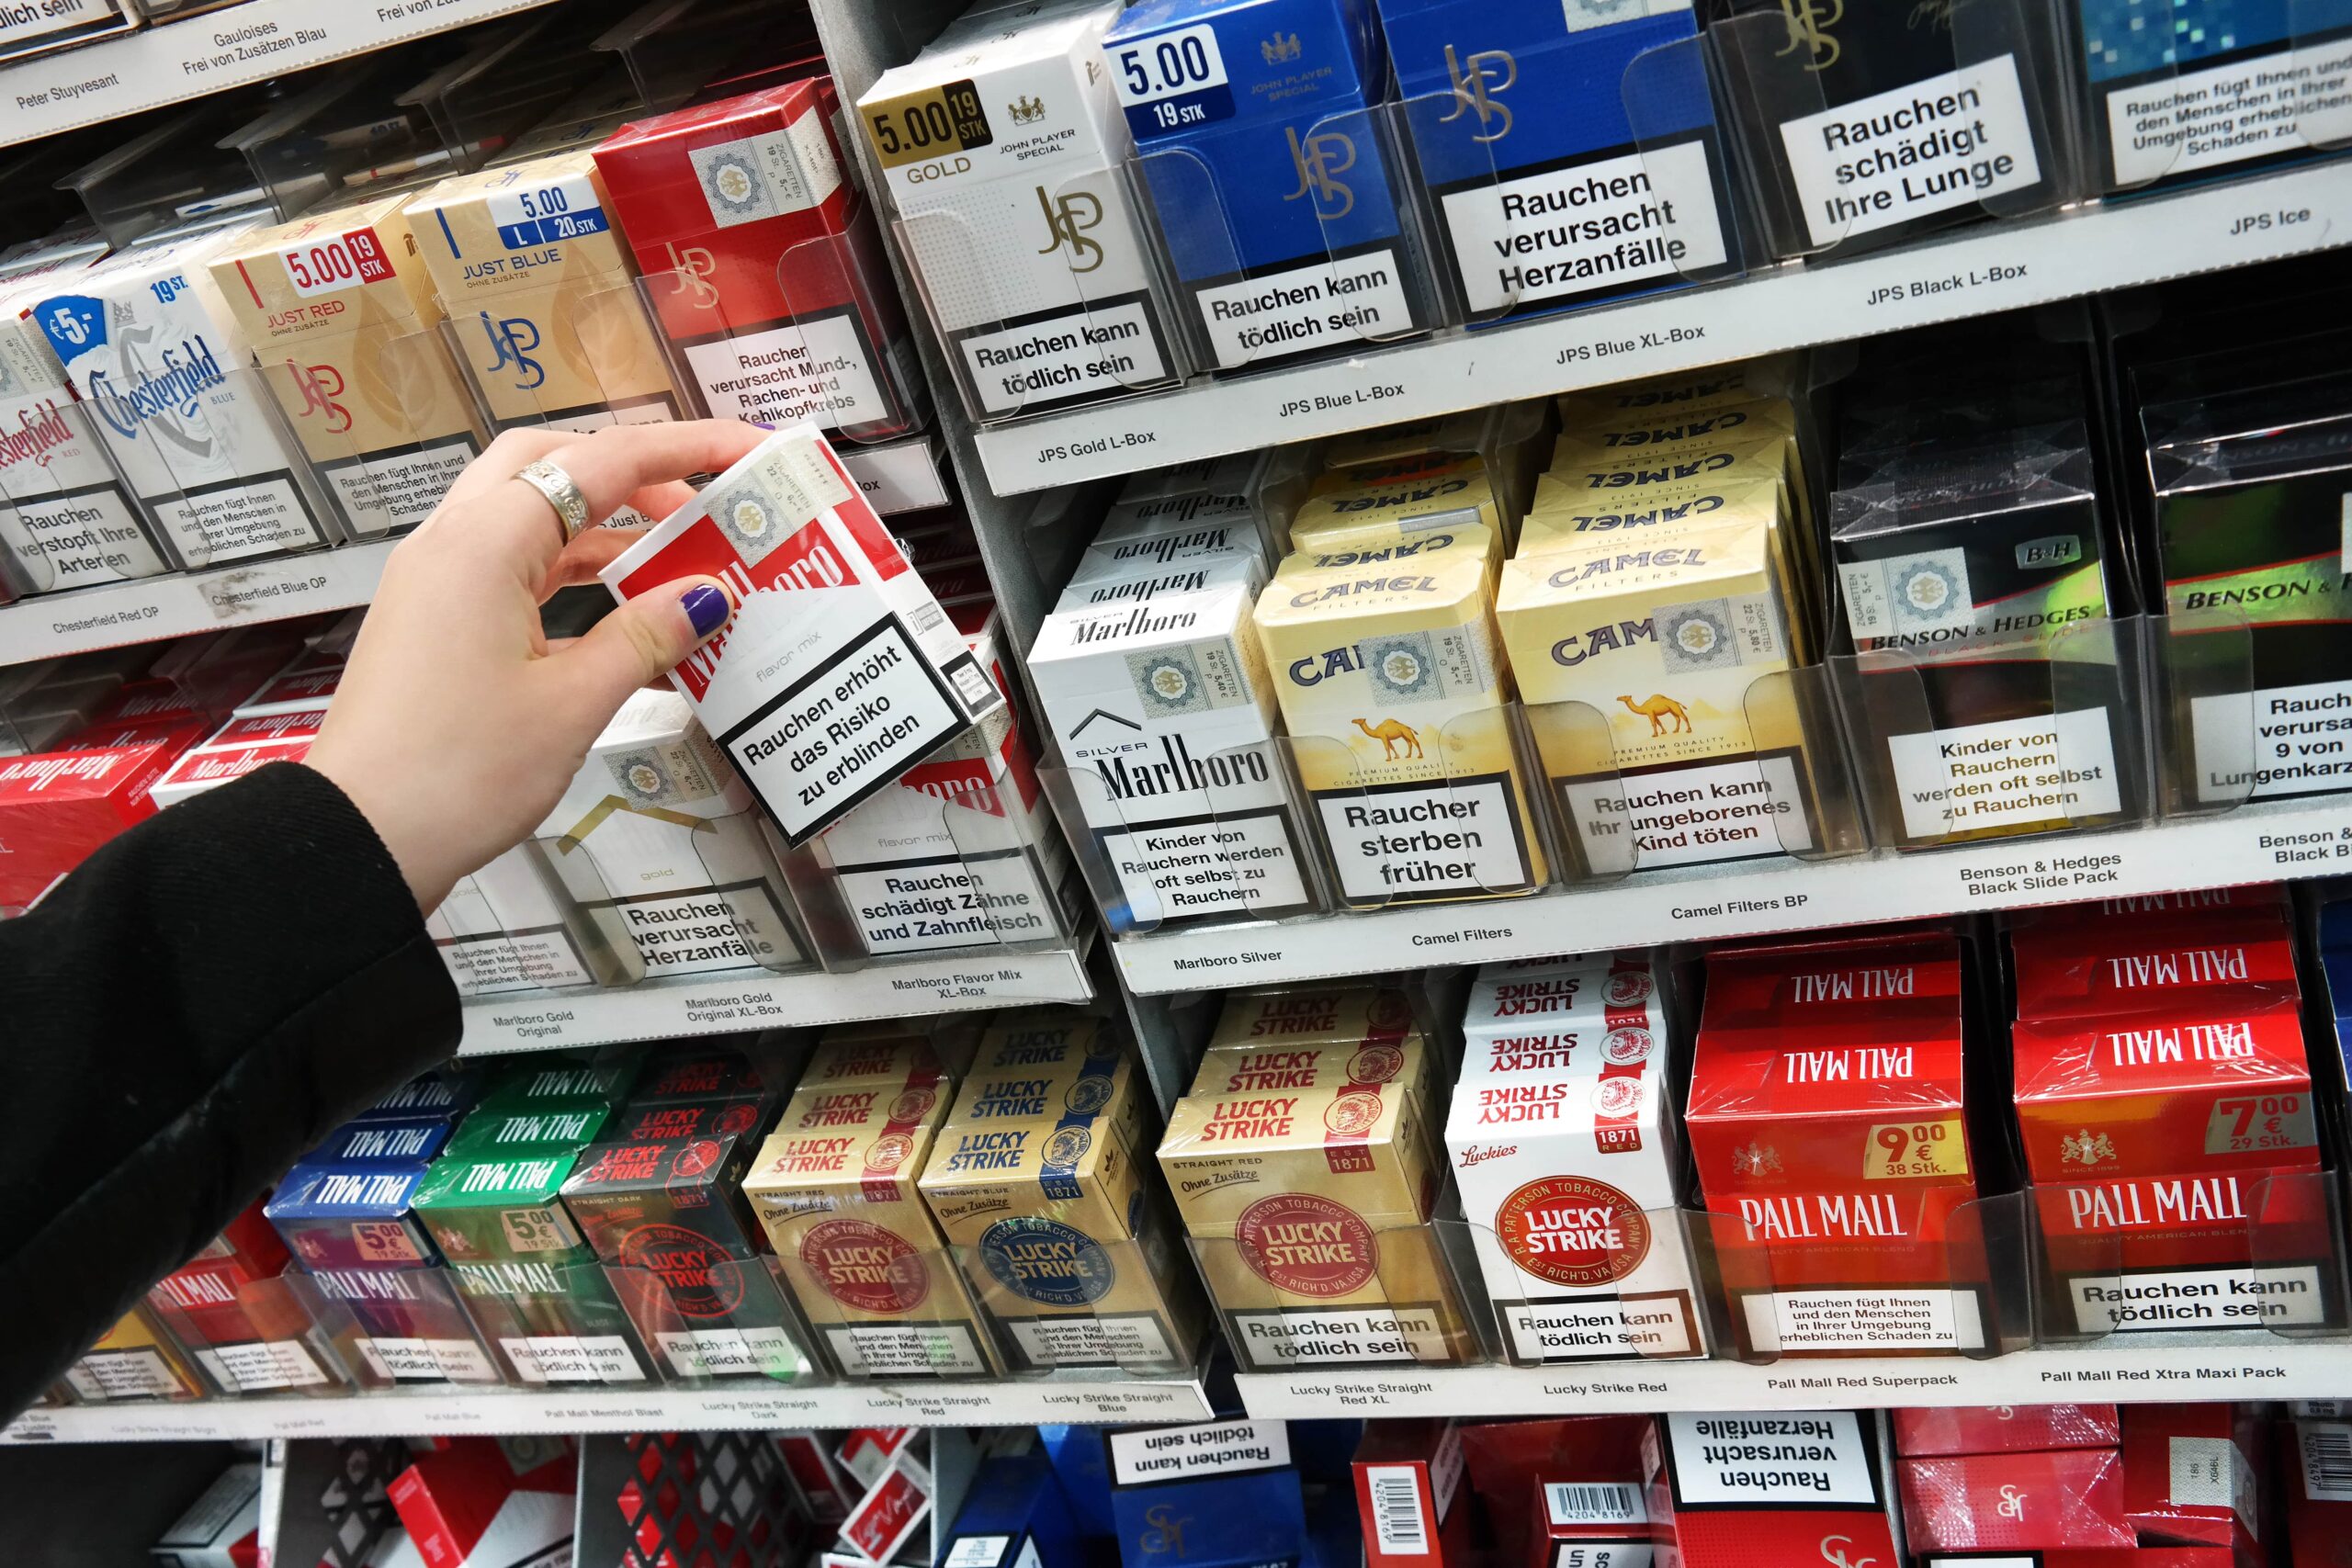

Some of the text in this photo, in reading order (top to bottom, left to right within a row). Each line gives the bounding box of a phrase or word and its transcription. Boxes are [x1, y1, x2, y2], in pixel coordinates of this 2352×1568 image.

[214, 21, 278, 48] Gauloises
[183, 27, 326, 75] Frei von Zusätzen Blau
[1122, 36, 1209, 96] 5.00
[17, 73, 119, 109] Peter Stuyvesant
[873, 92, 978, 154] 5.00 19
[1154, 104, 1205, 128] 19 STK
[1822, 83, 1981, 152] Rauchen
[959, 119, 987, 141] STK
[1000, 130, 1075, 153] JOHN PLAYER
[2186, 125, 2297, 155] Schaden zu
[1016, 144, 1064, 161] SPECIAL
[1835, 119, 1988, 185] schädigt
[907, 157, 971, 184] GOLD
[519, 186, 568, 218] 5.00
[1501, 171, 1652, 221] Rauchen
[1825, 152, 2016, 226] Ihre Lunge
[1495, 199, 1677, 259] verursacht
[2229, 207, 2311, 235] JPS Ice
[287, 234, 376, 288] 5.00 19
[360, 259, 386, 277] STK
[1498, 233, 1687, 294] Herzanfälle
[1867, 262, 2029, 305] JPS Black L-Box
[267, 300, 345, 328] JUST RED
[975, 319, 1140, 368] Rauchen kann
[1555, 325, 1705, 366] JPS Blue XL-Box
[90, 334, 227, 439] Chesterfield
[710, 367, 797, 394] verursacht
[210, 392, 235, 405] BLUE
[1280, 385, 1405, 417] JPS Blue L-Box
[1038, 431, 1156, 464] JPS Gold L-Box
[1548, 548, 1706, 588] CAMEL
[1576, 571, 1678, 592] FILTERS
[2186, 581, 2311, 610] BENSON
[52, 606, 159, 634] Chesterfield Red OP
[1070, 607, 1196, 645] Marlboro
[1870, 605, 2091, 650] BENSON & HEDGES
[756, 632, 822, 683] flavor mix
[743, 694, 840, 766] Rauchen
[836, 644, 902, 703] erhöht
[790, 694, 891, 773] das Risiko
[1613, 736, 1725, 756] PREMIUM QUALITY
[1940, 733, 2058, 759] Kinder von
[797, 712, 920, 807] zu erblinden
[1076, 742, 1148, 758] SILVER
[1093, 734, 1269, 802] Marlboro
[1951, 752, 2056, 778] Rauchern
[1710, 779, 1772, 797] kann
[1345, 799, 1480, 828] Raucher
[1630, 799, 1791, 831] ungeborenes
[1361, 831, 1482, 857] sterben
[1633, 825, 1758, 852] Kind töten
[1381, 862, 1476, 885] früher
[1960, 852, 2122, 882] Benson & Hedges
[885, 873, 984, 893] Rauchen
[1969, 869, 2118, 897] Black Slide Pack
[862, 895, 956, 919] schädigt
[1671, 895, 1808, 919] Camel Filters BP
[1412, 926, 1513, 946] Camel Filters
[1174, 950, 1283, 970] Marlboro Silver
[892, 969, 1022, 990] Marlboro Flavor Mix
[685, 992, 773, 1010] Marlboro Gold
[937, 987, 986, 999] XL-Box
[686, 1004, 784, 1022] Original XL-Box
[1214, 1098, 1298, 1122] LUCKY
[958, 1131, 1031, 1152] LUCKY
[1201, 1117, 1295, 1142] STRIKE
[1599, 1129, 1636, 1144] 1871
[945, 1151, 1023, 1172] STRIKE
[1173, 1157, 1262, 1169] STRAIGHT RED
[1459, 1145, 1517, 1168] Luckies
[1885, 1163, 1947, 1175] 38 Stk.
[1182, 1167, 1258, 1192] Ohne Zusätze
[2067, 1178, 2247, 1229] PALL MALL
[1525, 1206, 1613, 1233] LUCKY
[1739, 1194, 1907, 1241] PALL MALL
[1261, 1222, 1343, 1244] LUCKY
[1526, 1229, 1623, 1254] STRIKE
[1266, 1244, 1356, 1267] STRIKE
[1788, 1298, 1930, 1309] Rauchen fügt Ihnen
[2083, 1279, 2307, 1303] Rauchen kann
[1768, 1374, 1958, 1389] Pall Mall Red Superpack
[2041, 1367, 2286, 1382] Pall Mall Red Xtra Maxi Pack
[1290, 1383, 1432, 1396] Lucky Strike Straight
[1340, 1395, 1389, 1405] Red XL
[1544, 1382, 1668, 1394] Lucky Strike Red
[866, 1396, 991, 1409] Lucky Strike Straight
[1696, 1419, 1833, 1439] Herzanfälle
[1704, 1446, 1837, 1462] verursacht
[1721, 1472, 1830, 1490] Rauchen
